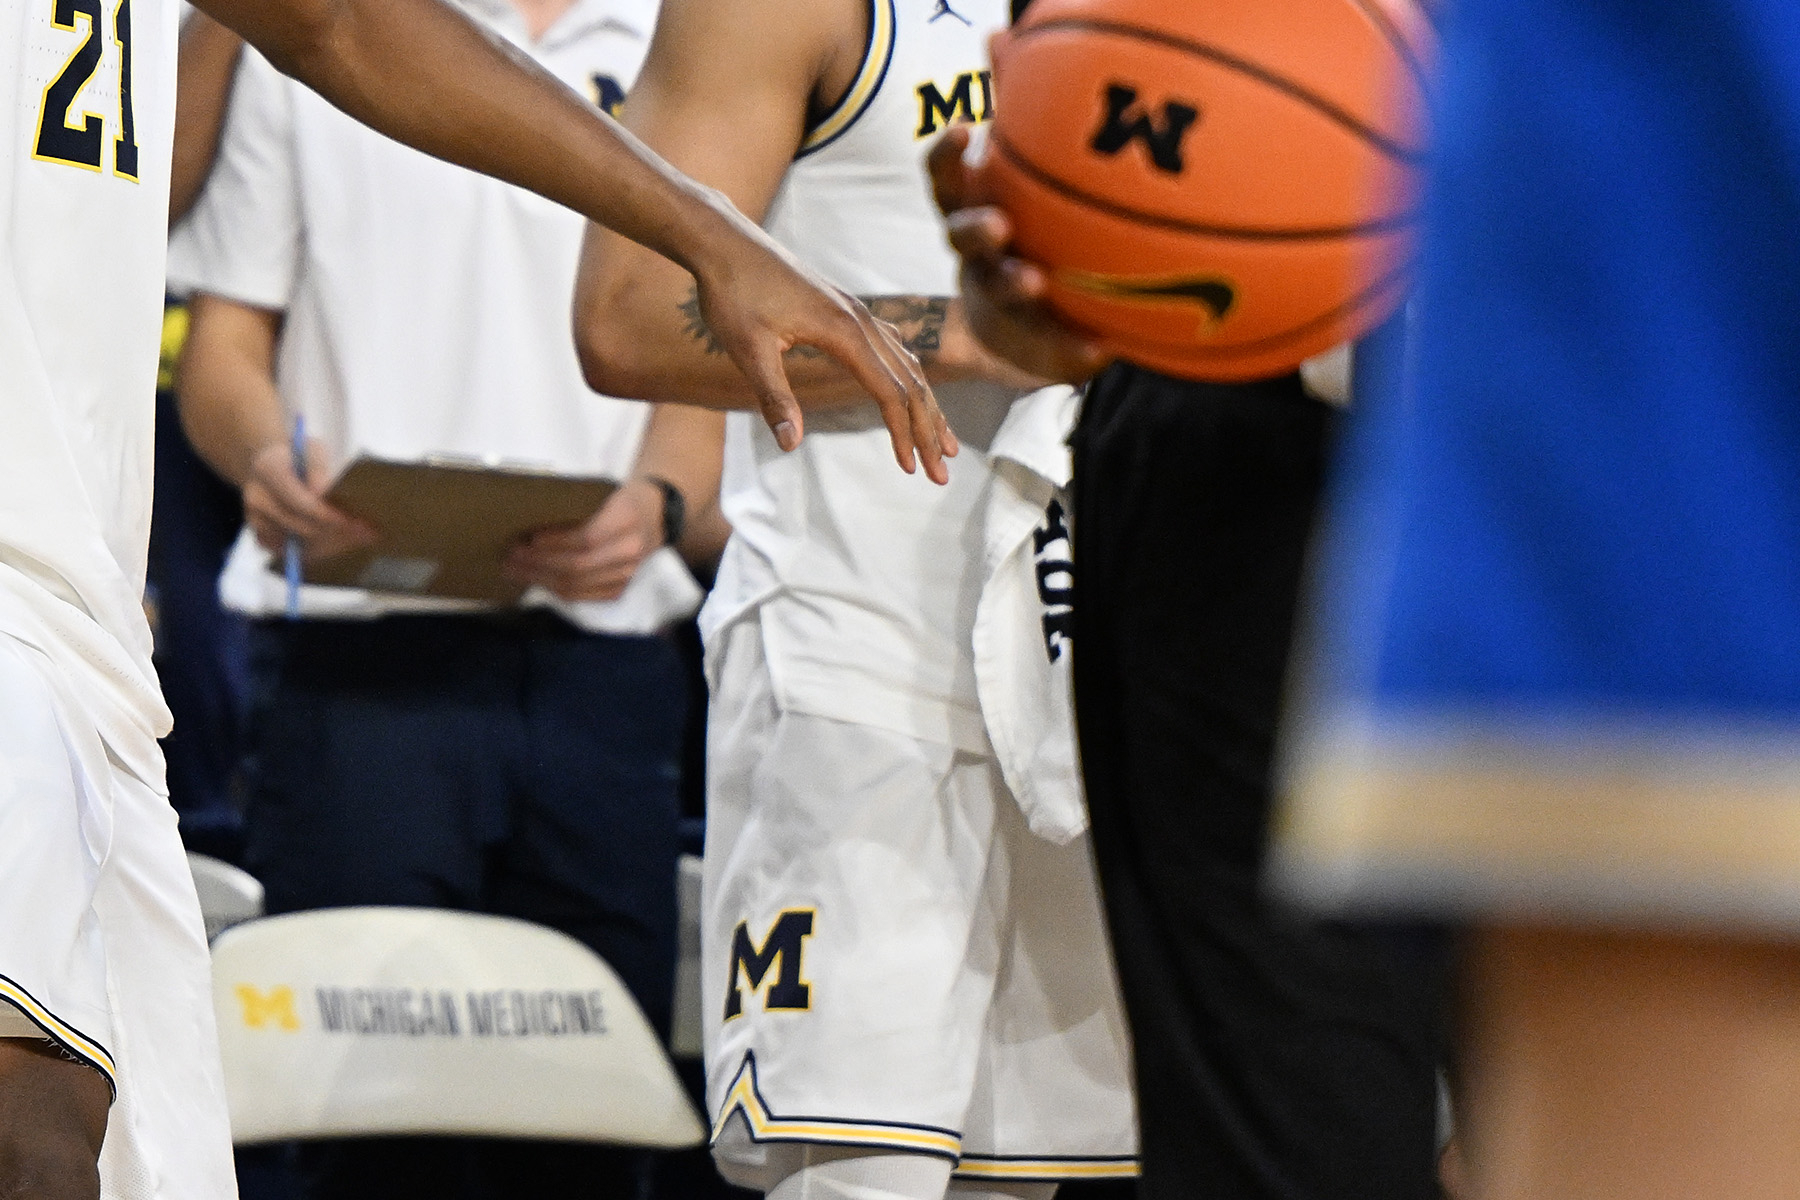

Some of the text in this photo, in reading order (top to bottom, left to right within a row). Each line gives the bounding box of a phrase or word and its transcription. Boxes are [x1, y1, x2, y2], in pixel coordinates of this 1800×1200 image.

[722, 905, 818, 1022] M
[234, 983, 300, 1030] M
[466, 987, 609, 1038] MEDICINE
